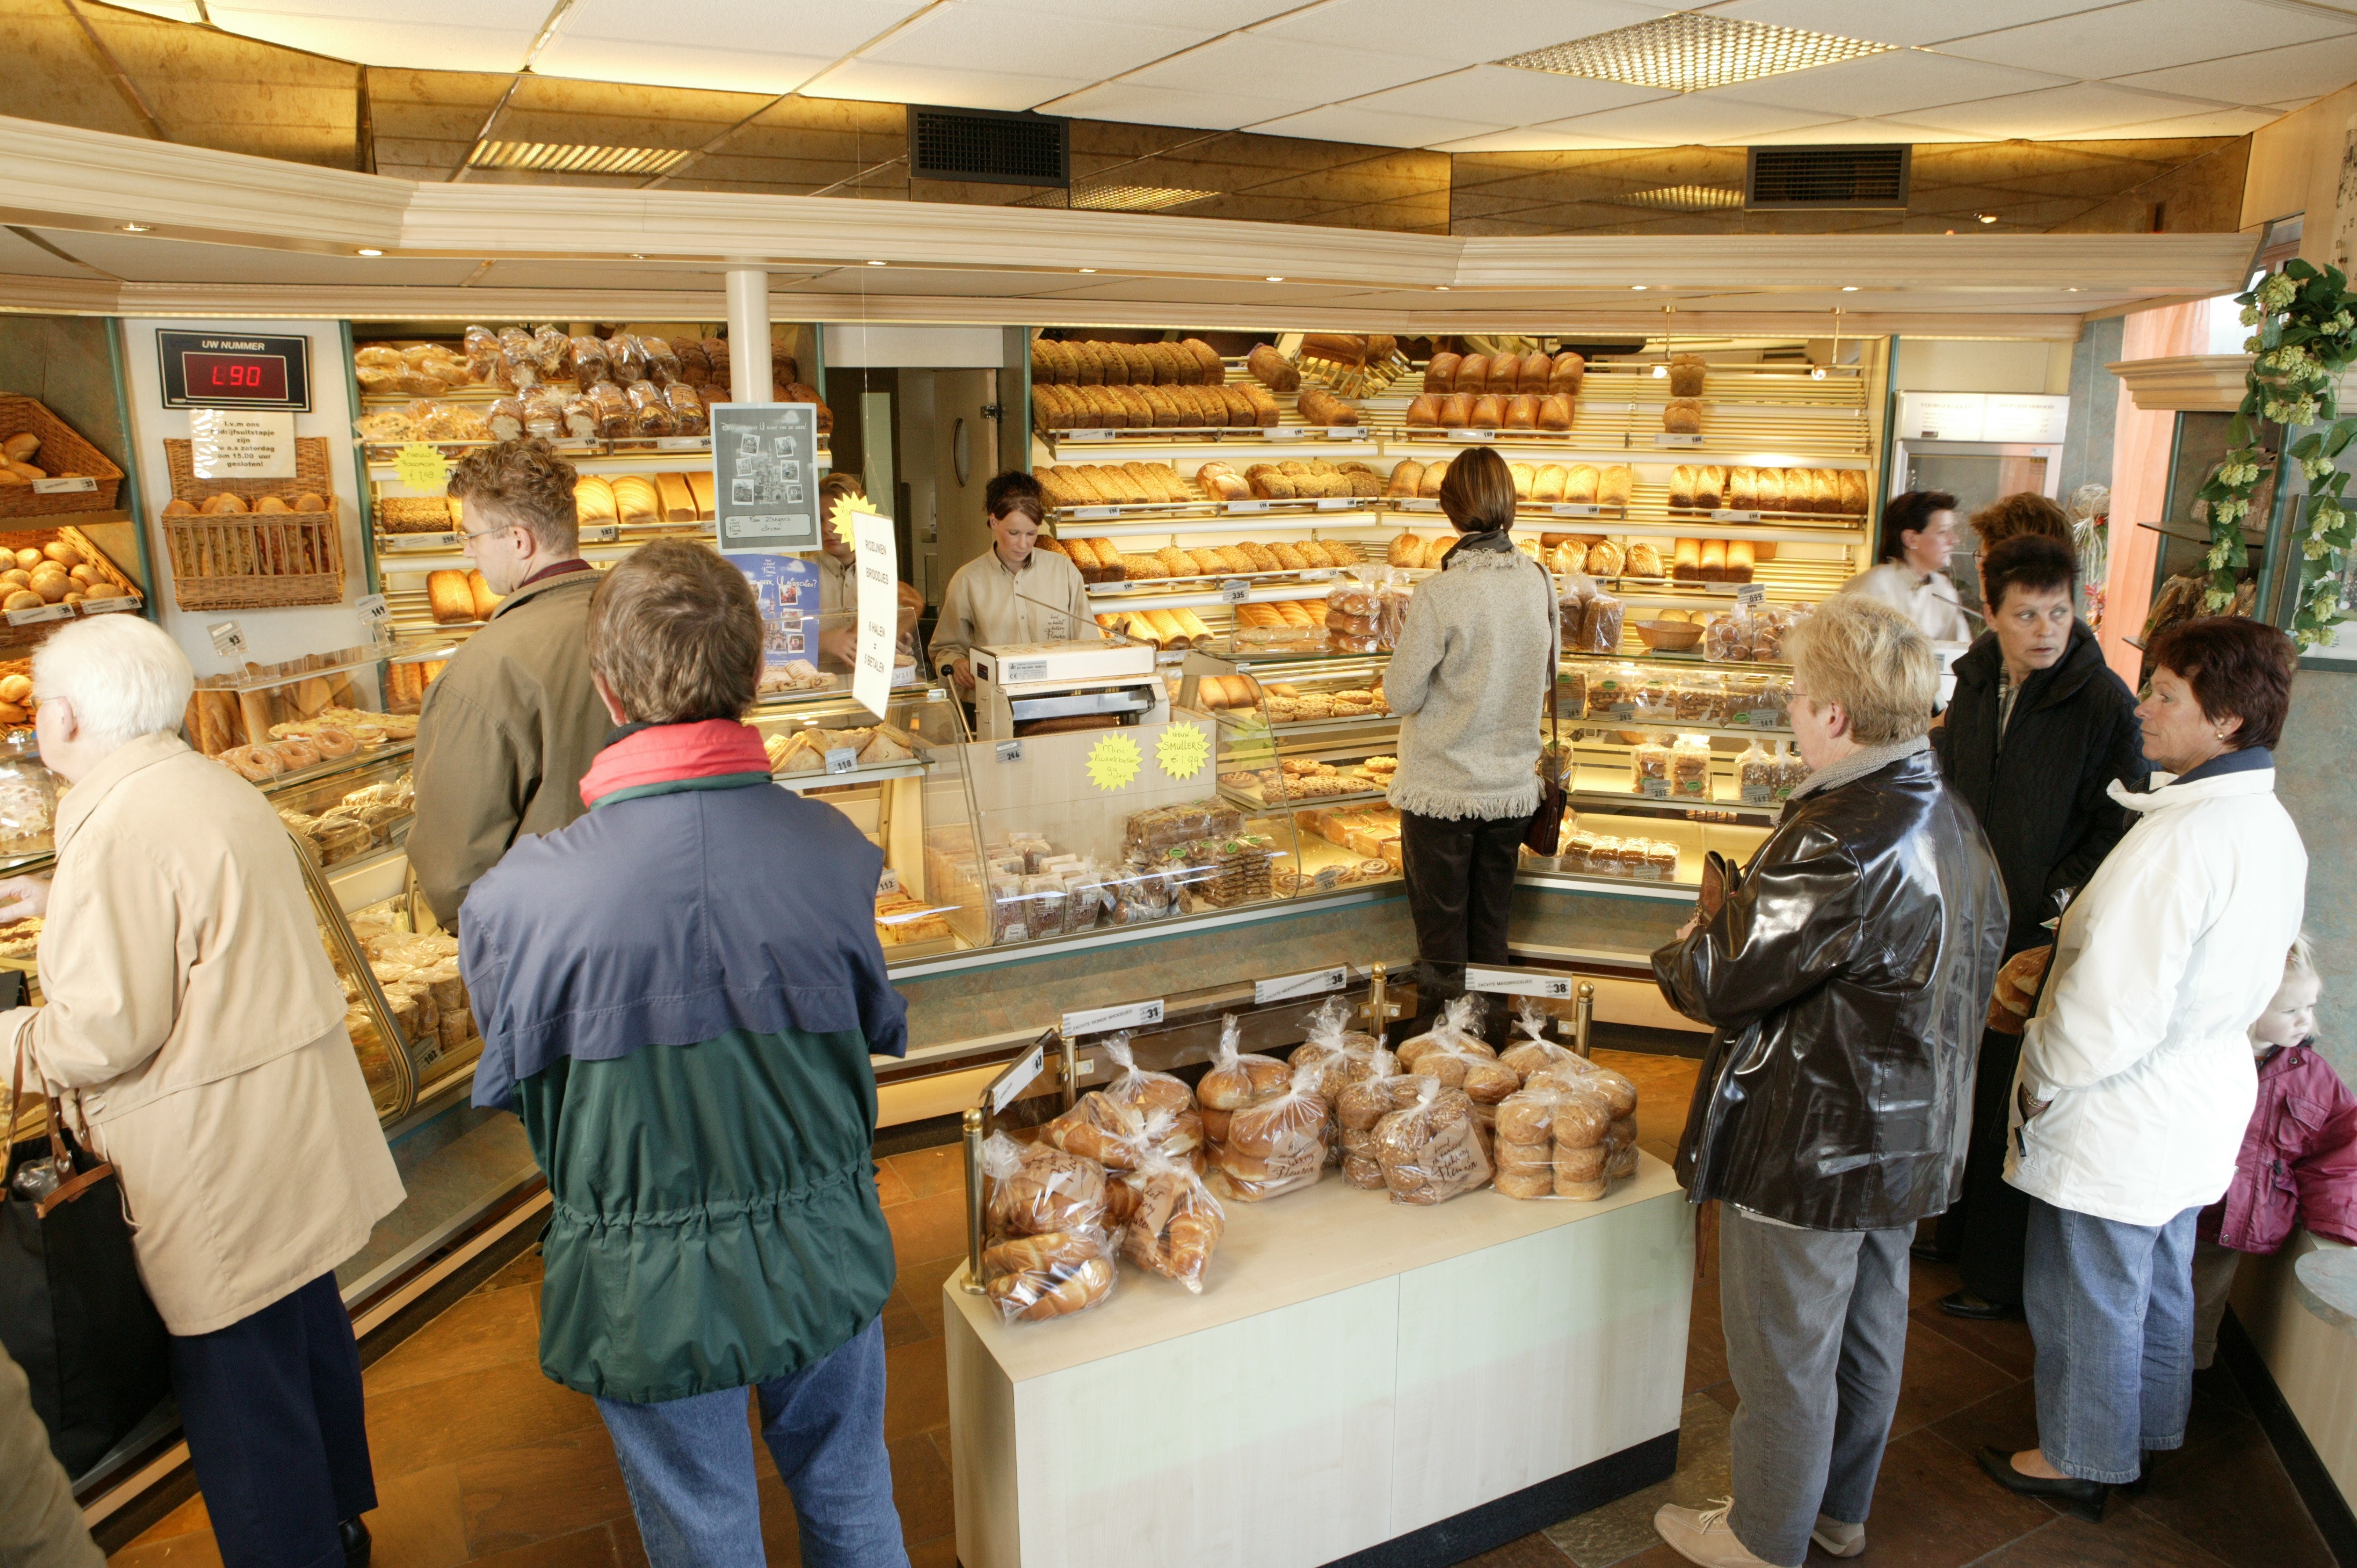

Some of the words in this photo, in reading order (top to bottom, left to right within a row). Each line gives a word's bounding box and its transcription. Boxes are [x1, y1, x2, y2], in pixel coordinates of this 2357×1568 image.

[202, 340, 219, 349] UW
[220, 340, 265, 351] NUMMER
[865, 539, 887, 556] ROZIJNEN
[866, 567, 889, 585] BROODJES
[1232, 591, 1245, 600] 335
[371, 605, 385, 617] 149
[872, 623, 885, 638] HALEN
[229, 635, 240, 646] 93
[868, 655, 884, 674] BETALEN
[1170, 754, 1178, 763] €
[837, 760, 852, 770] 118
[880, 880, 894, 891] 112
[1266, 990, 1281, 1000] ZACHTE
[1332, 973, 1343, 985] 38
[1553, 983, 1567, 993] 38
[1072, 1021, 1090, 1032] ZACHTE
[1091, 1017, 1107, 1026] RONDE
[1108, 1008, 1133, 1021] BROODJES
[1147, 1007, 1159, 1019] 31
